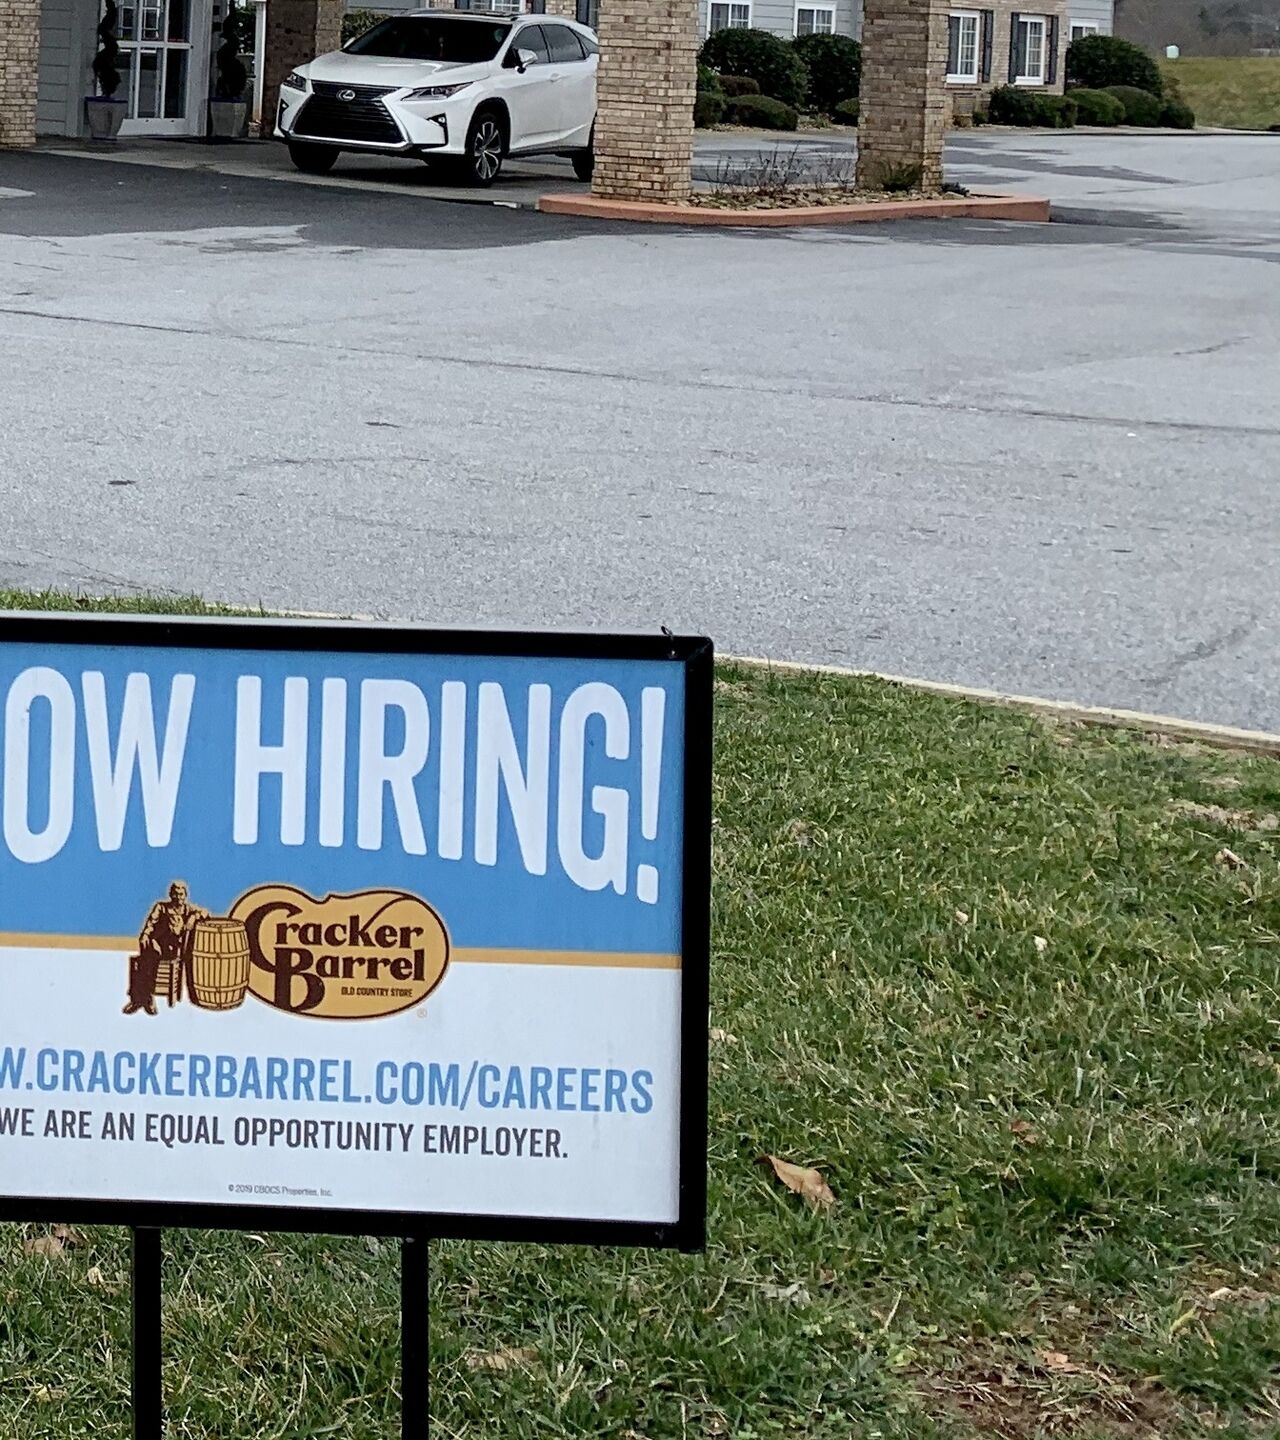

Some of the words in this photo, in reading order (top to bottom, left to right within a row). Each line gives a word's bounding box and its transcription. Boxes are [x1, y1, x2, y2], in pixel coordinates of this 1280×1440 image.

[232, 675, 666, 905] HIRING!
[244, 901, 424, 973] Cracker
[273, 946, 425, 1011] Barrel
[341, 986, 355, 996] OLD
[356, 987, 389, 997] COUNTRY
[391, 988, 413, 998] STORE
[43, 1109, 92, 1139] ARE
[101, 1112, 135, 1141] AN
[145, 1113, 225, 1148] EQUAL
[234, 1117, 415, 1152] OPPORTUNITY
[423, 1124, 568, 1159] EMPLOYER.
[254, 1185, 280, 1194] CBOCS
